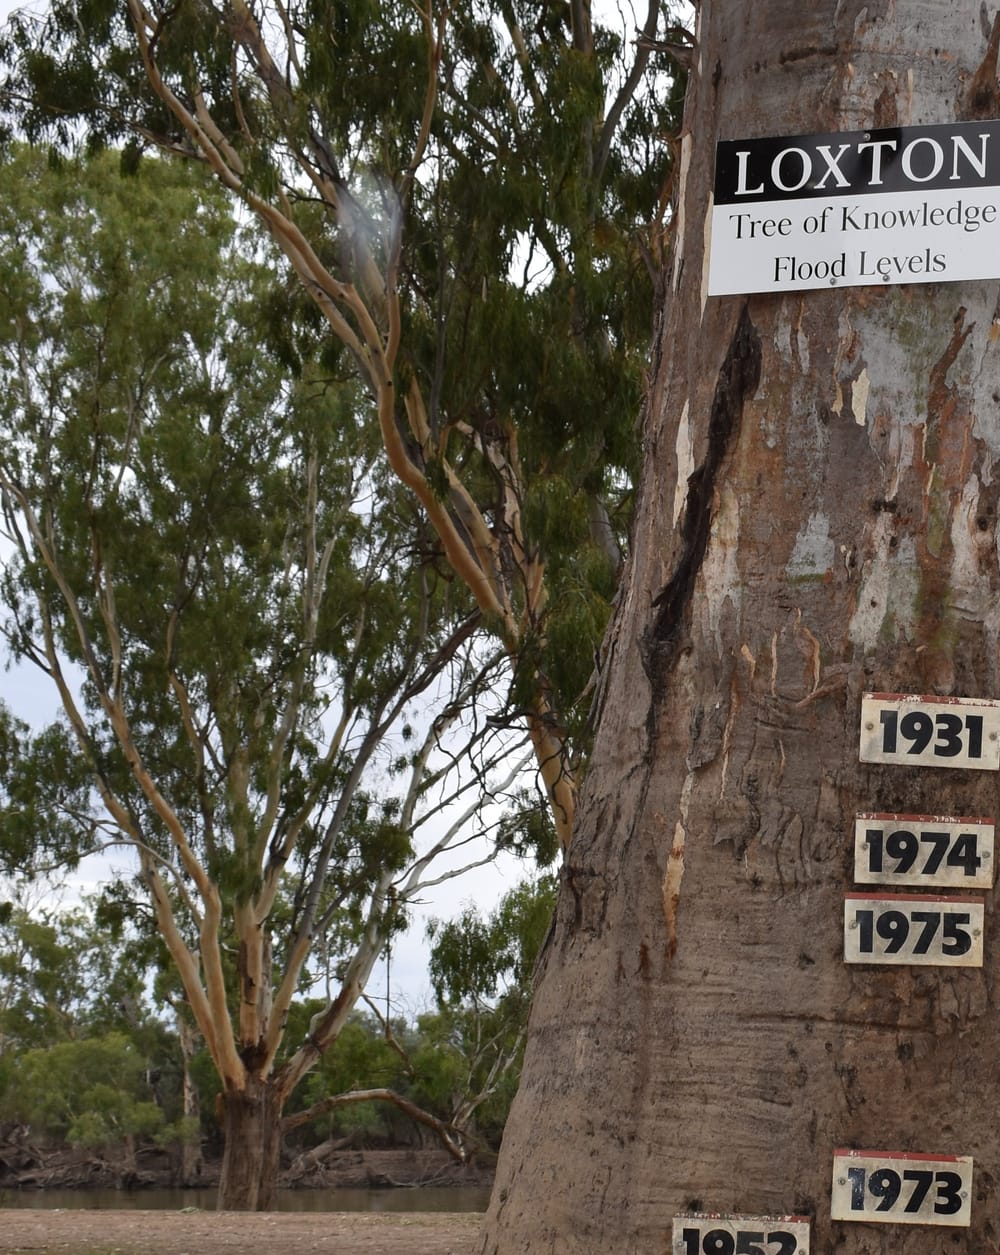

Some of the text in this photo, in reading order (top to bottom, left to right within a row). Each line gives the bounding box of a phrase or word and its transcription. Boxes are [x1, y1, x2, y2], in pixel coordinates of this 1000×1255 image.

[734, 134, 990, 195] LOXTON
[729, 200, 997, 239] Tree of Knowledge
[773, 248, 946, 282] Flood Levels
[880, 710, 983, 758] 1931
[866, 830, 981, 876] 1974
[856, 910, 972, 956] 1975
[847, 1167, 963, 1215] 1973
